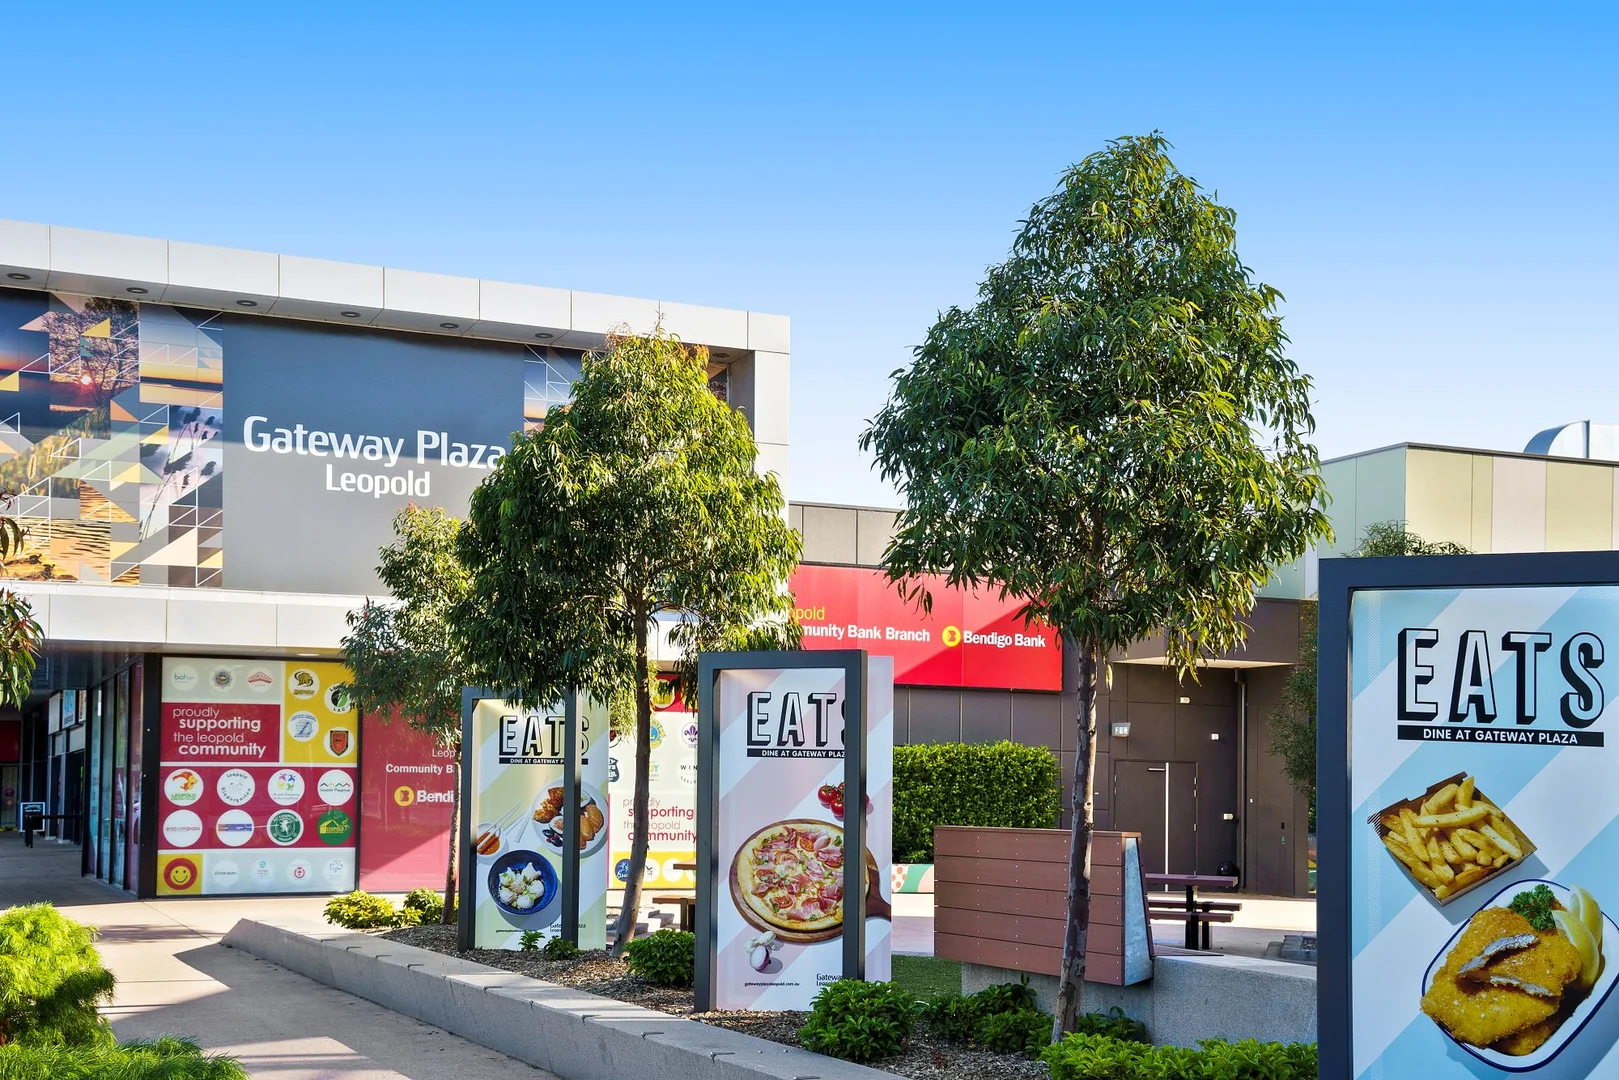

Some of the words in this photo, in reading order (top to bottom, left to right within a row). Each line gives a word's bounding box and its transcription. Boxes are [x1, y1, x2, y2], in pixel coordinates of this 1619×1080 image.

[243, 415, 404, 467] Gateway
[417, 430, 506, 469] Plaza
[326, 464, 430, 498] Leopold
[848, 625, 881, 639] Bank
[886, 627, 930, 641] Branch
[964, 630, 1012, 648] Bendigo
[1014, 634, 1046, 648] Bank
[1397, 628, 1605, 729] EATS
[172, 707, 220, 719] proudly
[747, 692, 845, 747] EAT
[179, 717, 261, 732] supporting
[174, 732, 194, 742] the
[197, 732, 244, 744] leopold
[1423, 728, 1452, 740] DINE
[1456, 730, 1472, 741] AT
[1474, 730, 1535, 743] GATEWAY
[1538, 732, 1578, 744] PLAZA
[178, 743, 266, 758] community
[432, 748, 456, 759] Leop
[792, 750, 827, 758] GATEWAY
[386, 764, 443, 776] Community
[416, 790, 455, 802] Bendi
[623, 798, 660, 808] prdly
[628, 806, 694, 820] sporting
[648, 821, 681, 831] opold
[628, 830, 697, 843] cmmunity
